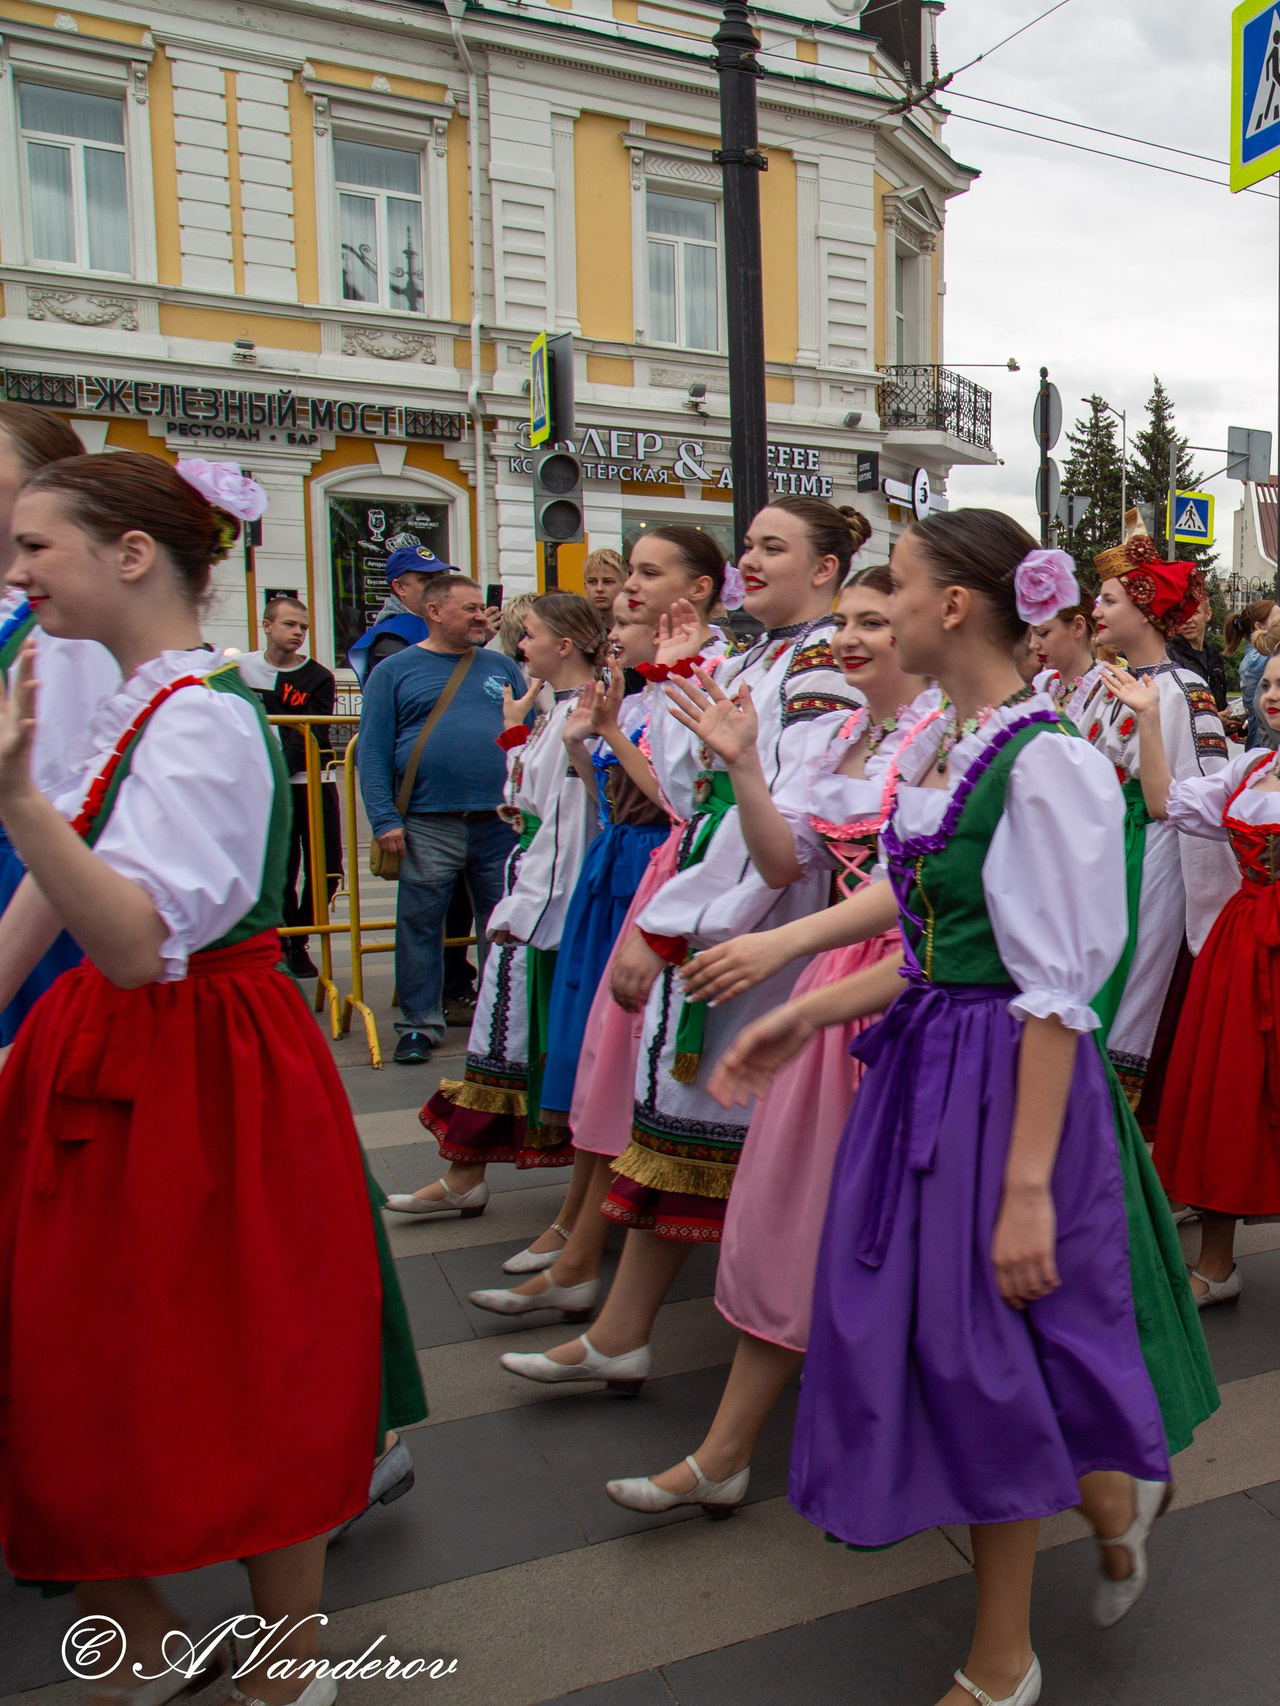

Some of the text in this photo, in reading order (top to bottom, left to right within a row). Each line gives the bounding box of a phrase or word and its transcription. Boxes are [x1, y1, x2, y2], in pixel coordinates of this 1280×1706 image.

[92, 376, 397, 437] ЖЕЛЕЗНЫЙ МОСТ
[166, 421, 319, 446] РЕСТОРАН БАР
[509, 457, 669, 484] КОТЕРСКАЯ
[716, 467, 834, 497] ATIME
